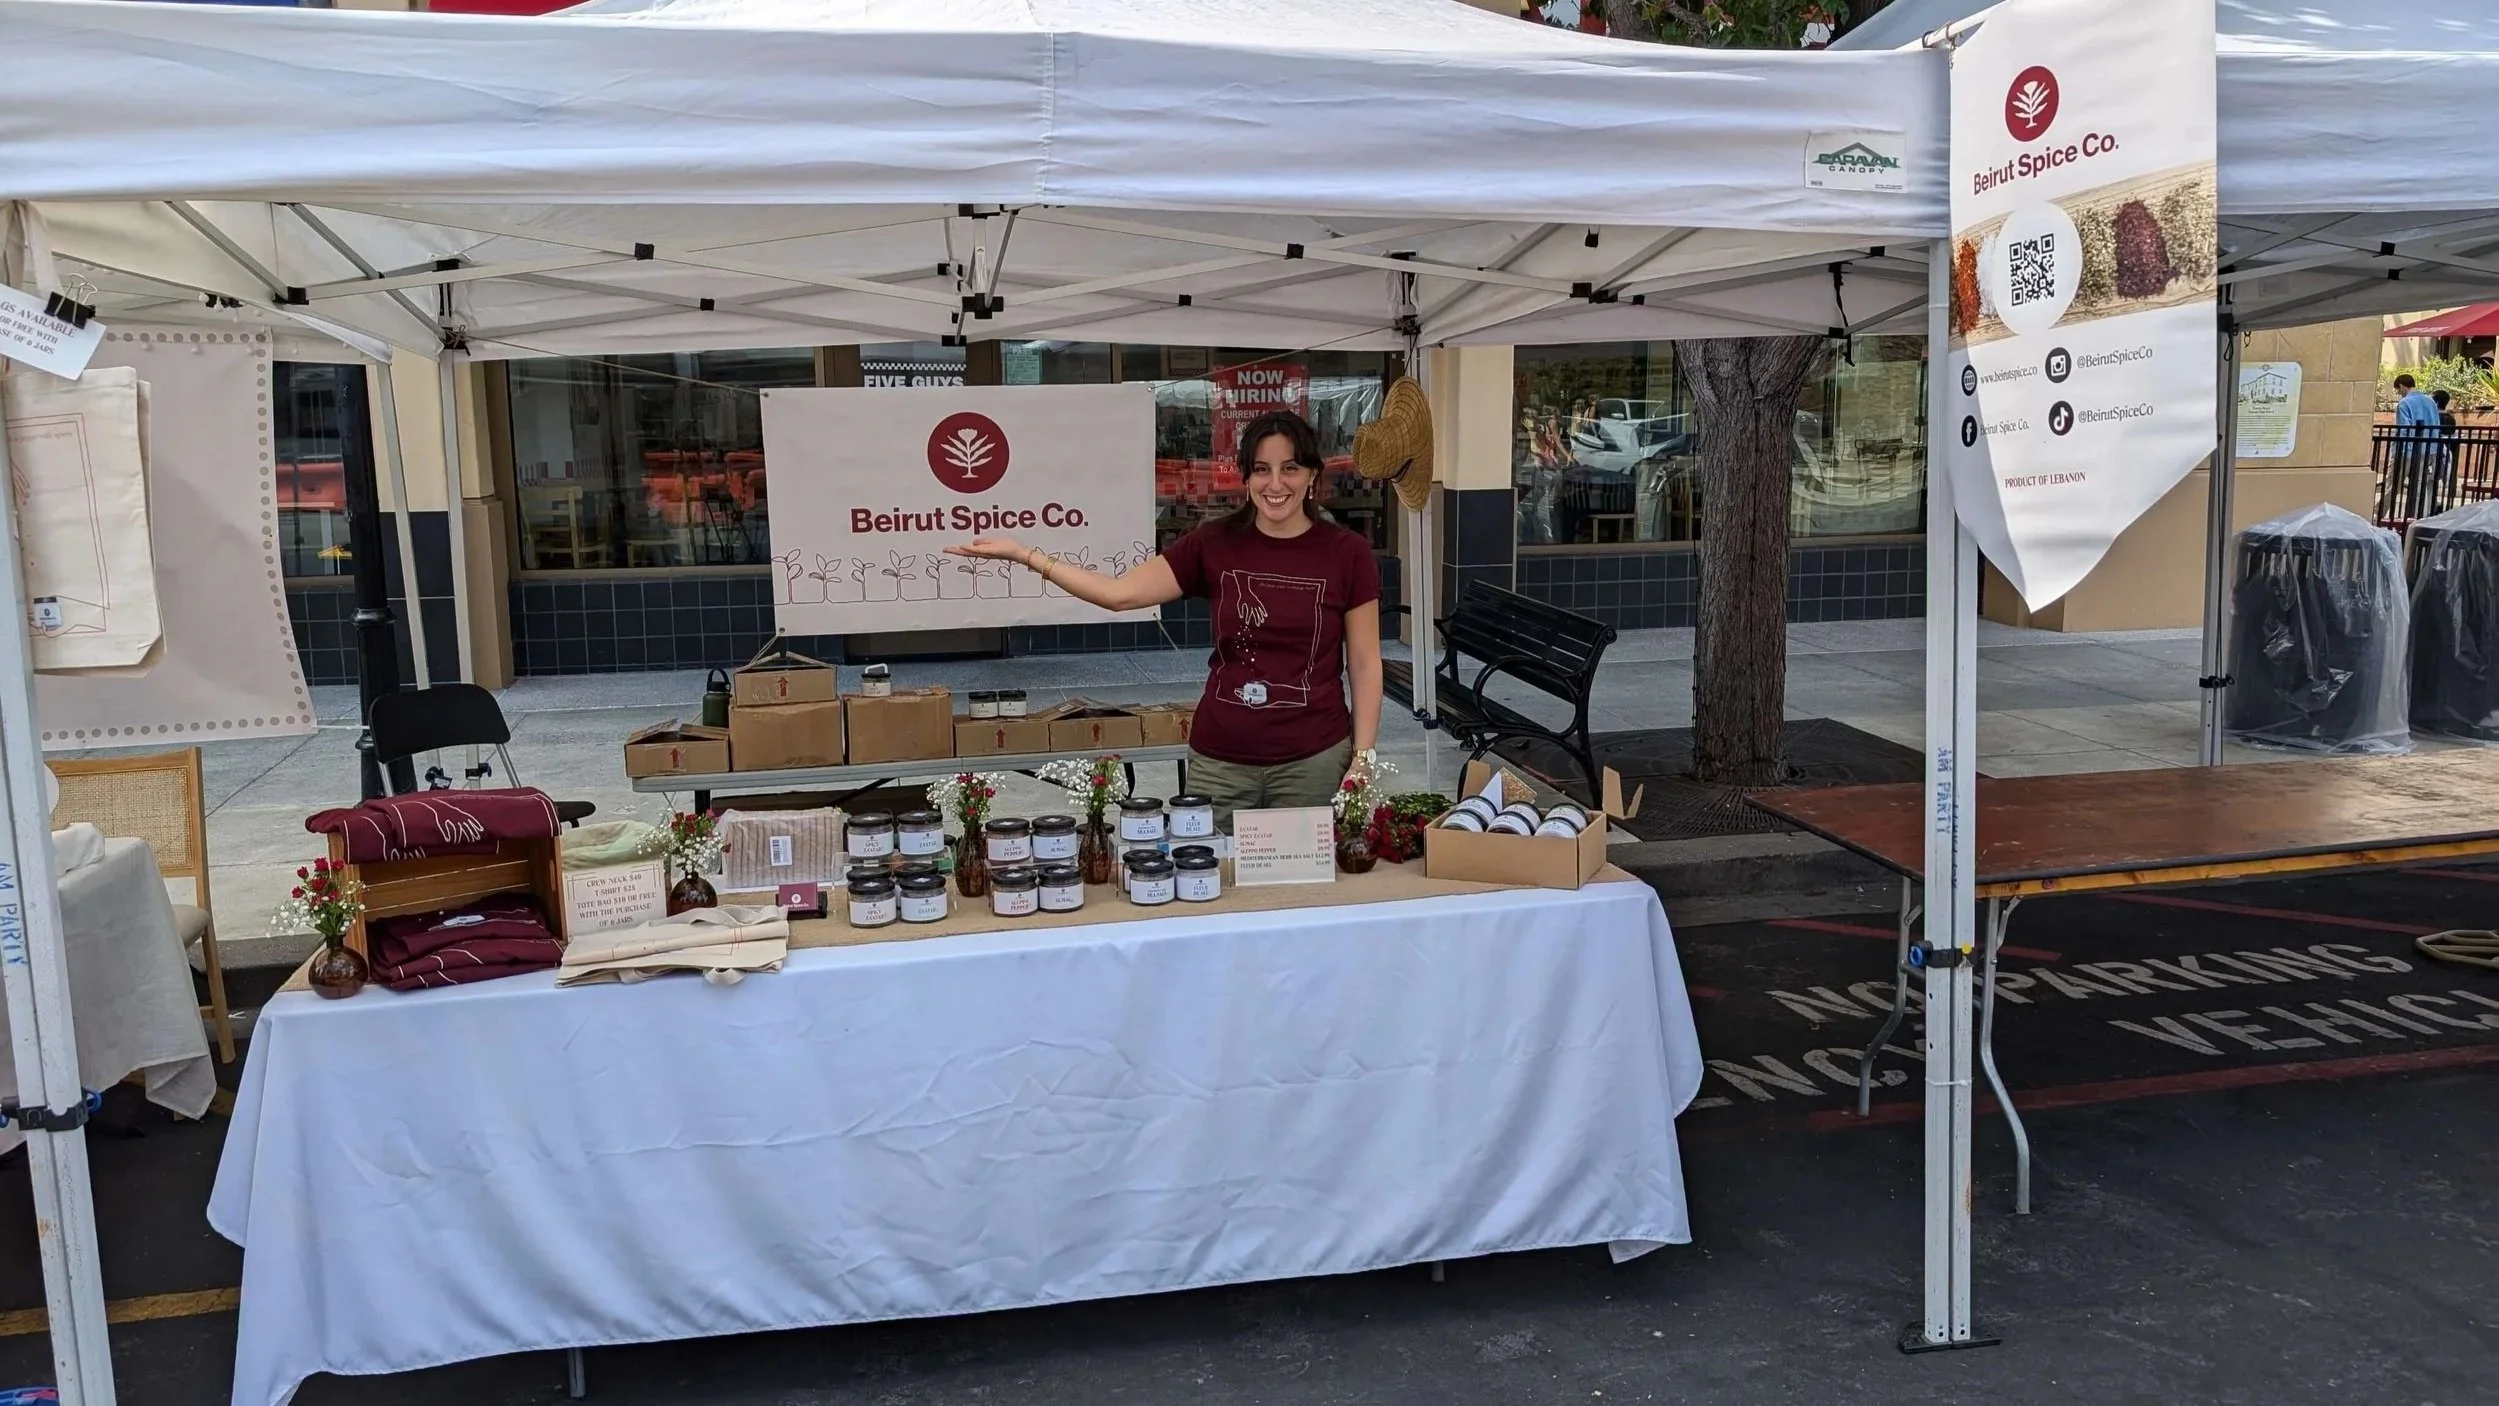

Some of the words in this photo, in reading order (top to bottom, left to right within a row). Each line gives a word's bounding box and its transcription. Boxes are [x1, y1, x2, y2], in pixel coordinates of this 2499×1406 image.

[1828, 165, 1884, 174] CANOPY
[1974, 159, 2015, 195] Beirut
[2018, 144, 2078, 178] Spice
[2082, 133, 2119, 157] Co.
[12, 320, 35, 335] FREE
[36, 330, 58, 344] WITH
[18, 309, 78, 338] AVAILABLE
[14, 333, 26, 343] OF
[33, 342, 55, 355] JARS
[2077, 346, 2153, 369] @BeirutSpiceCo
[863, 374, 906, 388] FIVE
[911, 375, 964, 388] GUYS
[1237, 370, 1284, 385] NOW
[1220, 409, 1259, 419] CURRENT
[2078, 403, 2153, 424] @BeirutSpiceCo
[1980, 422, 1998, 436] Beirut
[1999, 420, 2016, 435] Spice
[2004, 475, 2036, 488] PRODUCT
[2038, 474, 2048, 485] OF
[2050, 471, 2087, 484] LEBANON
[850, 507, 945, 533] Beirut
[951, 504, 1036, 535] Spice
[1041, 502, 1089, 528] Co.
[587, 879, 606, 887] CREW
[609, 876, 628, 884] NECK
[577, 900, 596, 909] TOTE
[639, 891, 656, 899] FREE
[579, 910, 598, 919] WITH
[601, 908, 614, 916] THE
[616, 903, 651, 914] PURCHASE
[616, 916, 633, 925] JARS
[1764, 981, 1925, 1023] NO
[1973, 944, 2413, 1004] PARKING
